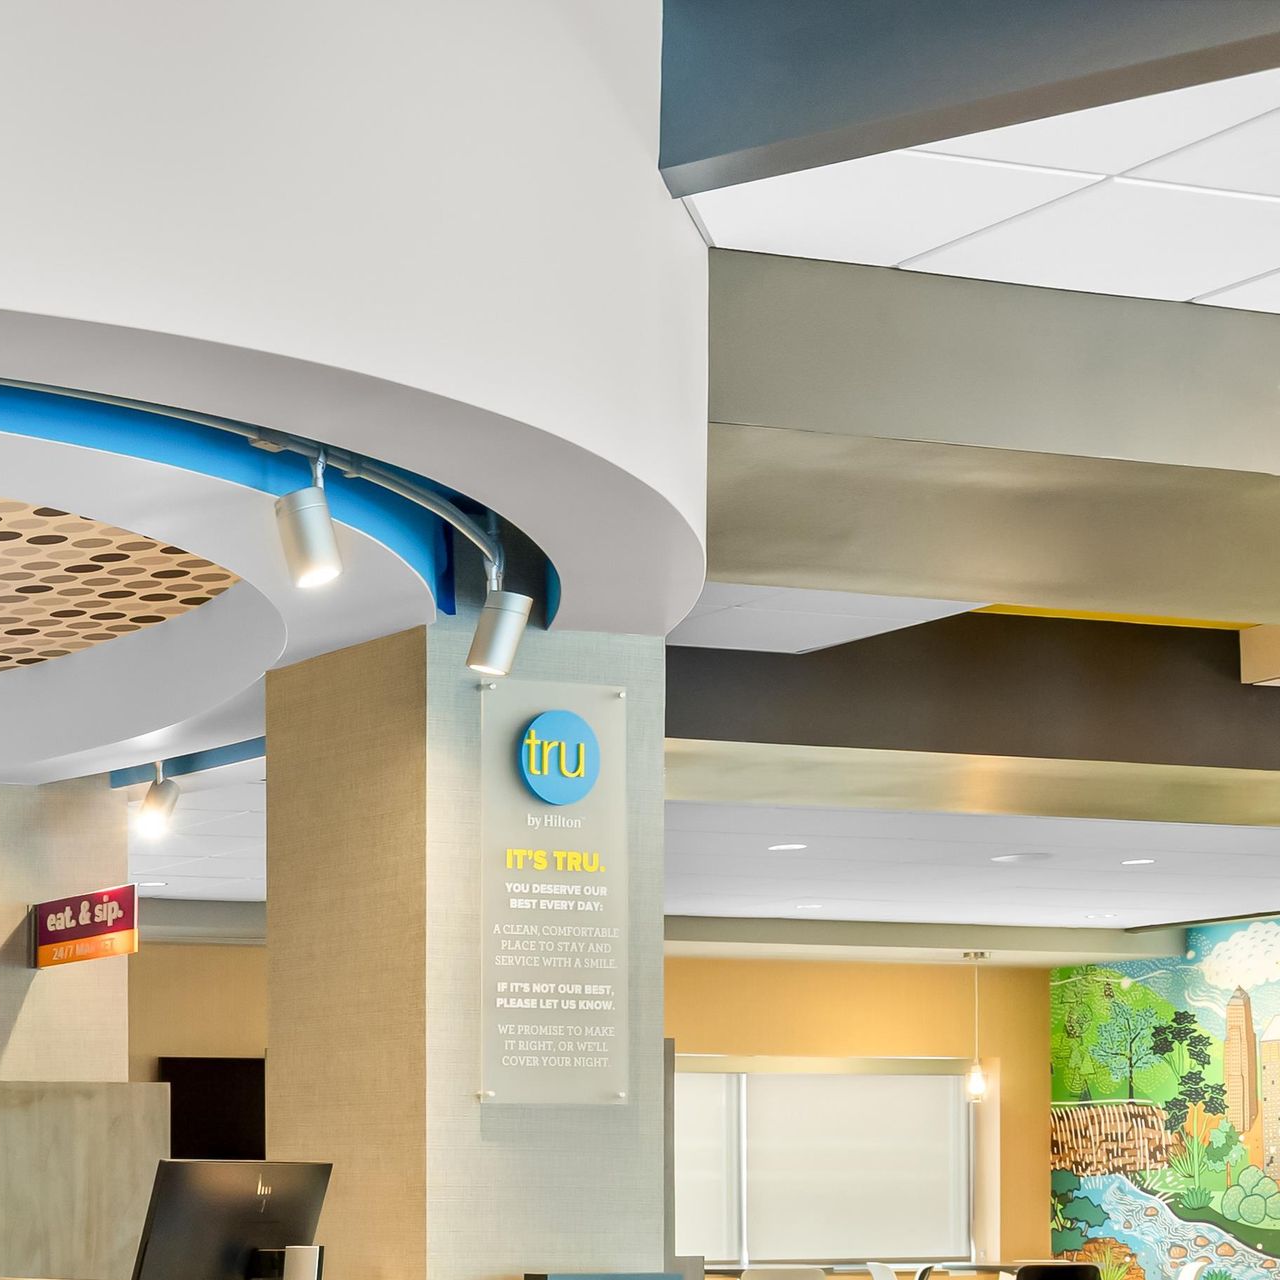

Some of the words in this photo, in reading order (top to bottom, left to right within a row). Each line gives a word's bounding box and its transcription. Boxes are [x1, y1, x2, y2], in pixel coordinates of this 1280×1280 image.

[524, 729, 586, 779] tru
[527, 813, 542, 831] by
[543, 814, 582, 829] Hilton
[505, 847, 549, 871] IT'S
[553, 850, 607, 873] TRU.
[505, 882, 530, 894] YOU
[531, 883, 582, 896] DESERVE
[583, 886, 609, 897] OUR
[78, 900, 92, 926] &
[94, 894, 124, 927] sip.
[509, 898, 538, 909] BEST
[539, 899, 576, 911] EVERY
[577, 901, 604, 912] DAY:
[492, 923, 501, 935] A
[502, 924, 541, 938] CLEAN,
[541, 925, 621, 939] COMFORTABLE
[52, 944, 74, 961] 24/7
[75, 937, 116, 957] MAET
[501, 939, 537, 952] PLACE
[538, 940, 555, 952] TO
[556, 941, 586, 953] STAY
[587, 942, 612, 954] AND
[495, 954, 540, 968] SERVICE
[541, 956, 572, 968] WITH
[573, 957, 582, 968] A
[496, 982, 509, 993] IF
[509, 982, 531, 993] IT'S
[532, 982, 557, 994] NOT
[557, 984, 583, 995] OUR
[584, 984, 616, 997] BEST,
[496, 997, 538, 1008] PLEASE
[539, 998, 559, 1009] LET
[560, 999, 577, 1010] US
[578, 999, 617, 1011] KNOW.
[497, 1024, 516, 1035] WE
[517, 1024, 565, 1037] PROMISE
[566, 1025, 583, 1036] TO
[584, 1026, 616, 1037] MAKE
[504, 1040, 517, 1050] IT
[518, 1040, 557, 1053] RIGHT,
[557, 1041, 575, 1052] OR
[576, 1041, 609, 1053] WE'LL
[501, 1055, 540, 1067] COVER
[541, 1055, 572, 1067] YOUR
